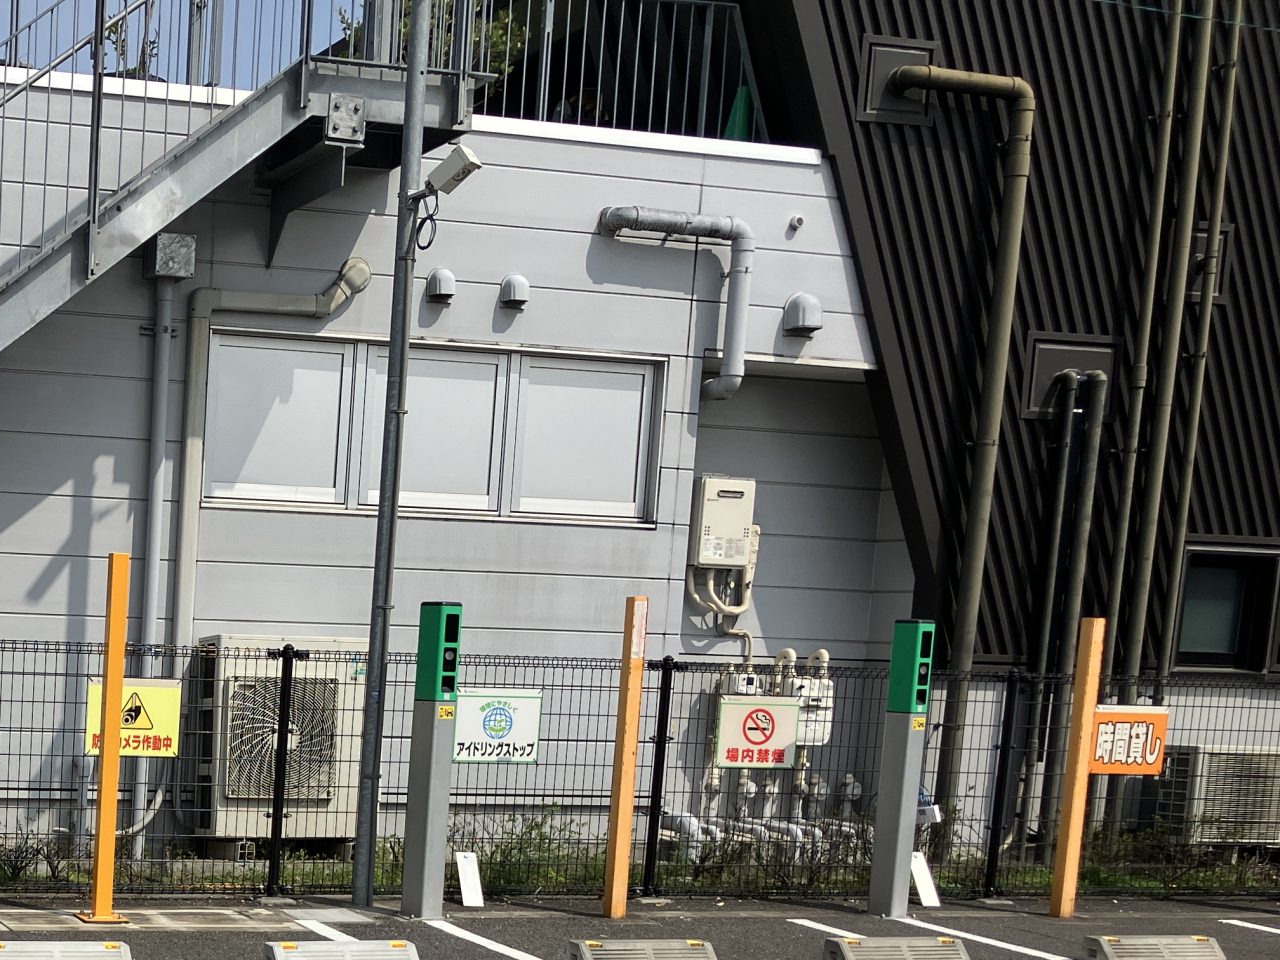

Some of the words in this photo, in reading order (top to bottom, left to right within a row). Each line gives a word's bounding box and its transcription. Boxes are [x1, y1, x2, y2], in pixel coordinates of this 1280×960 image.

[92, 733, 172, 752] 防メラ作動中
[456, 741, 535, 757] アイドリングストップ
[1094, 721, 1161, 765] 時間貸し
[725, 748, 786, 764] 場内禁煙
